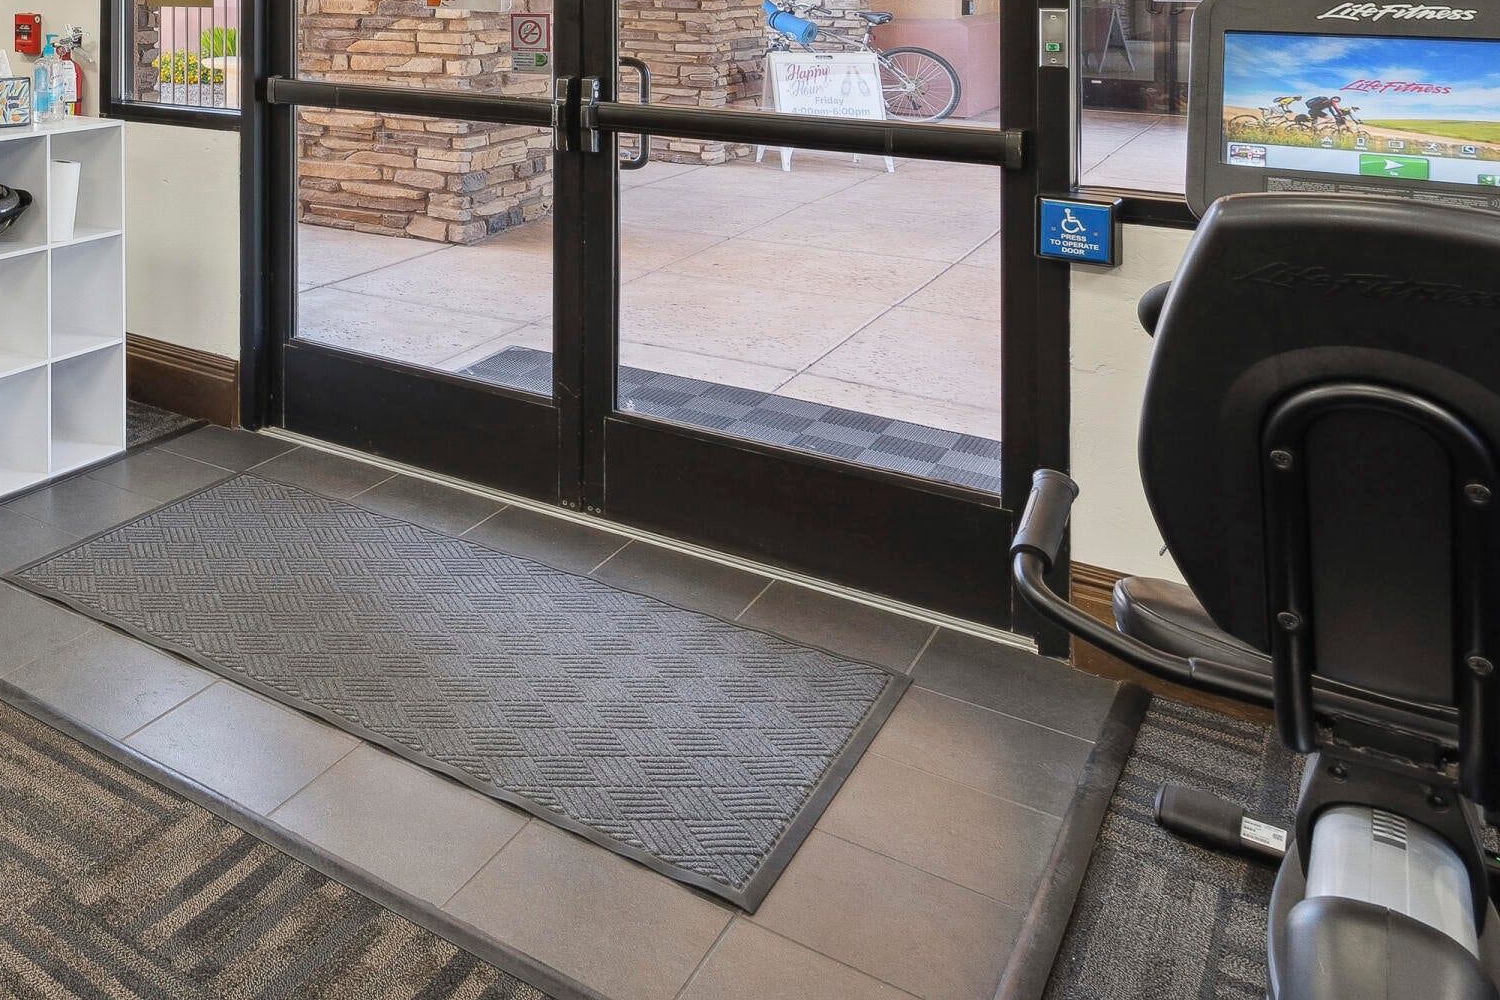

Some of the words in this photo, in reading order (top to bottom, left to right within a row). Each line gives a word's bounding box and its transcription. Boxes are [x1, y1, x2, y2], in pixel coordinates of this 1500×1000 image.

[786, 63, 831, 83] Happy
[815, 96, 844, 105] Friday
[1061, 234, 1087, 242] PRESS
[1050, 238, 1061, 246] TO
[1062, 240, 1099, 251] OPERATE
[1061, 247, 1085, 255] DOOR
